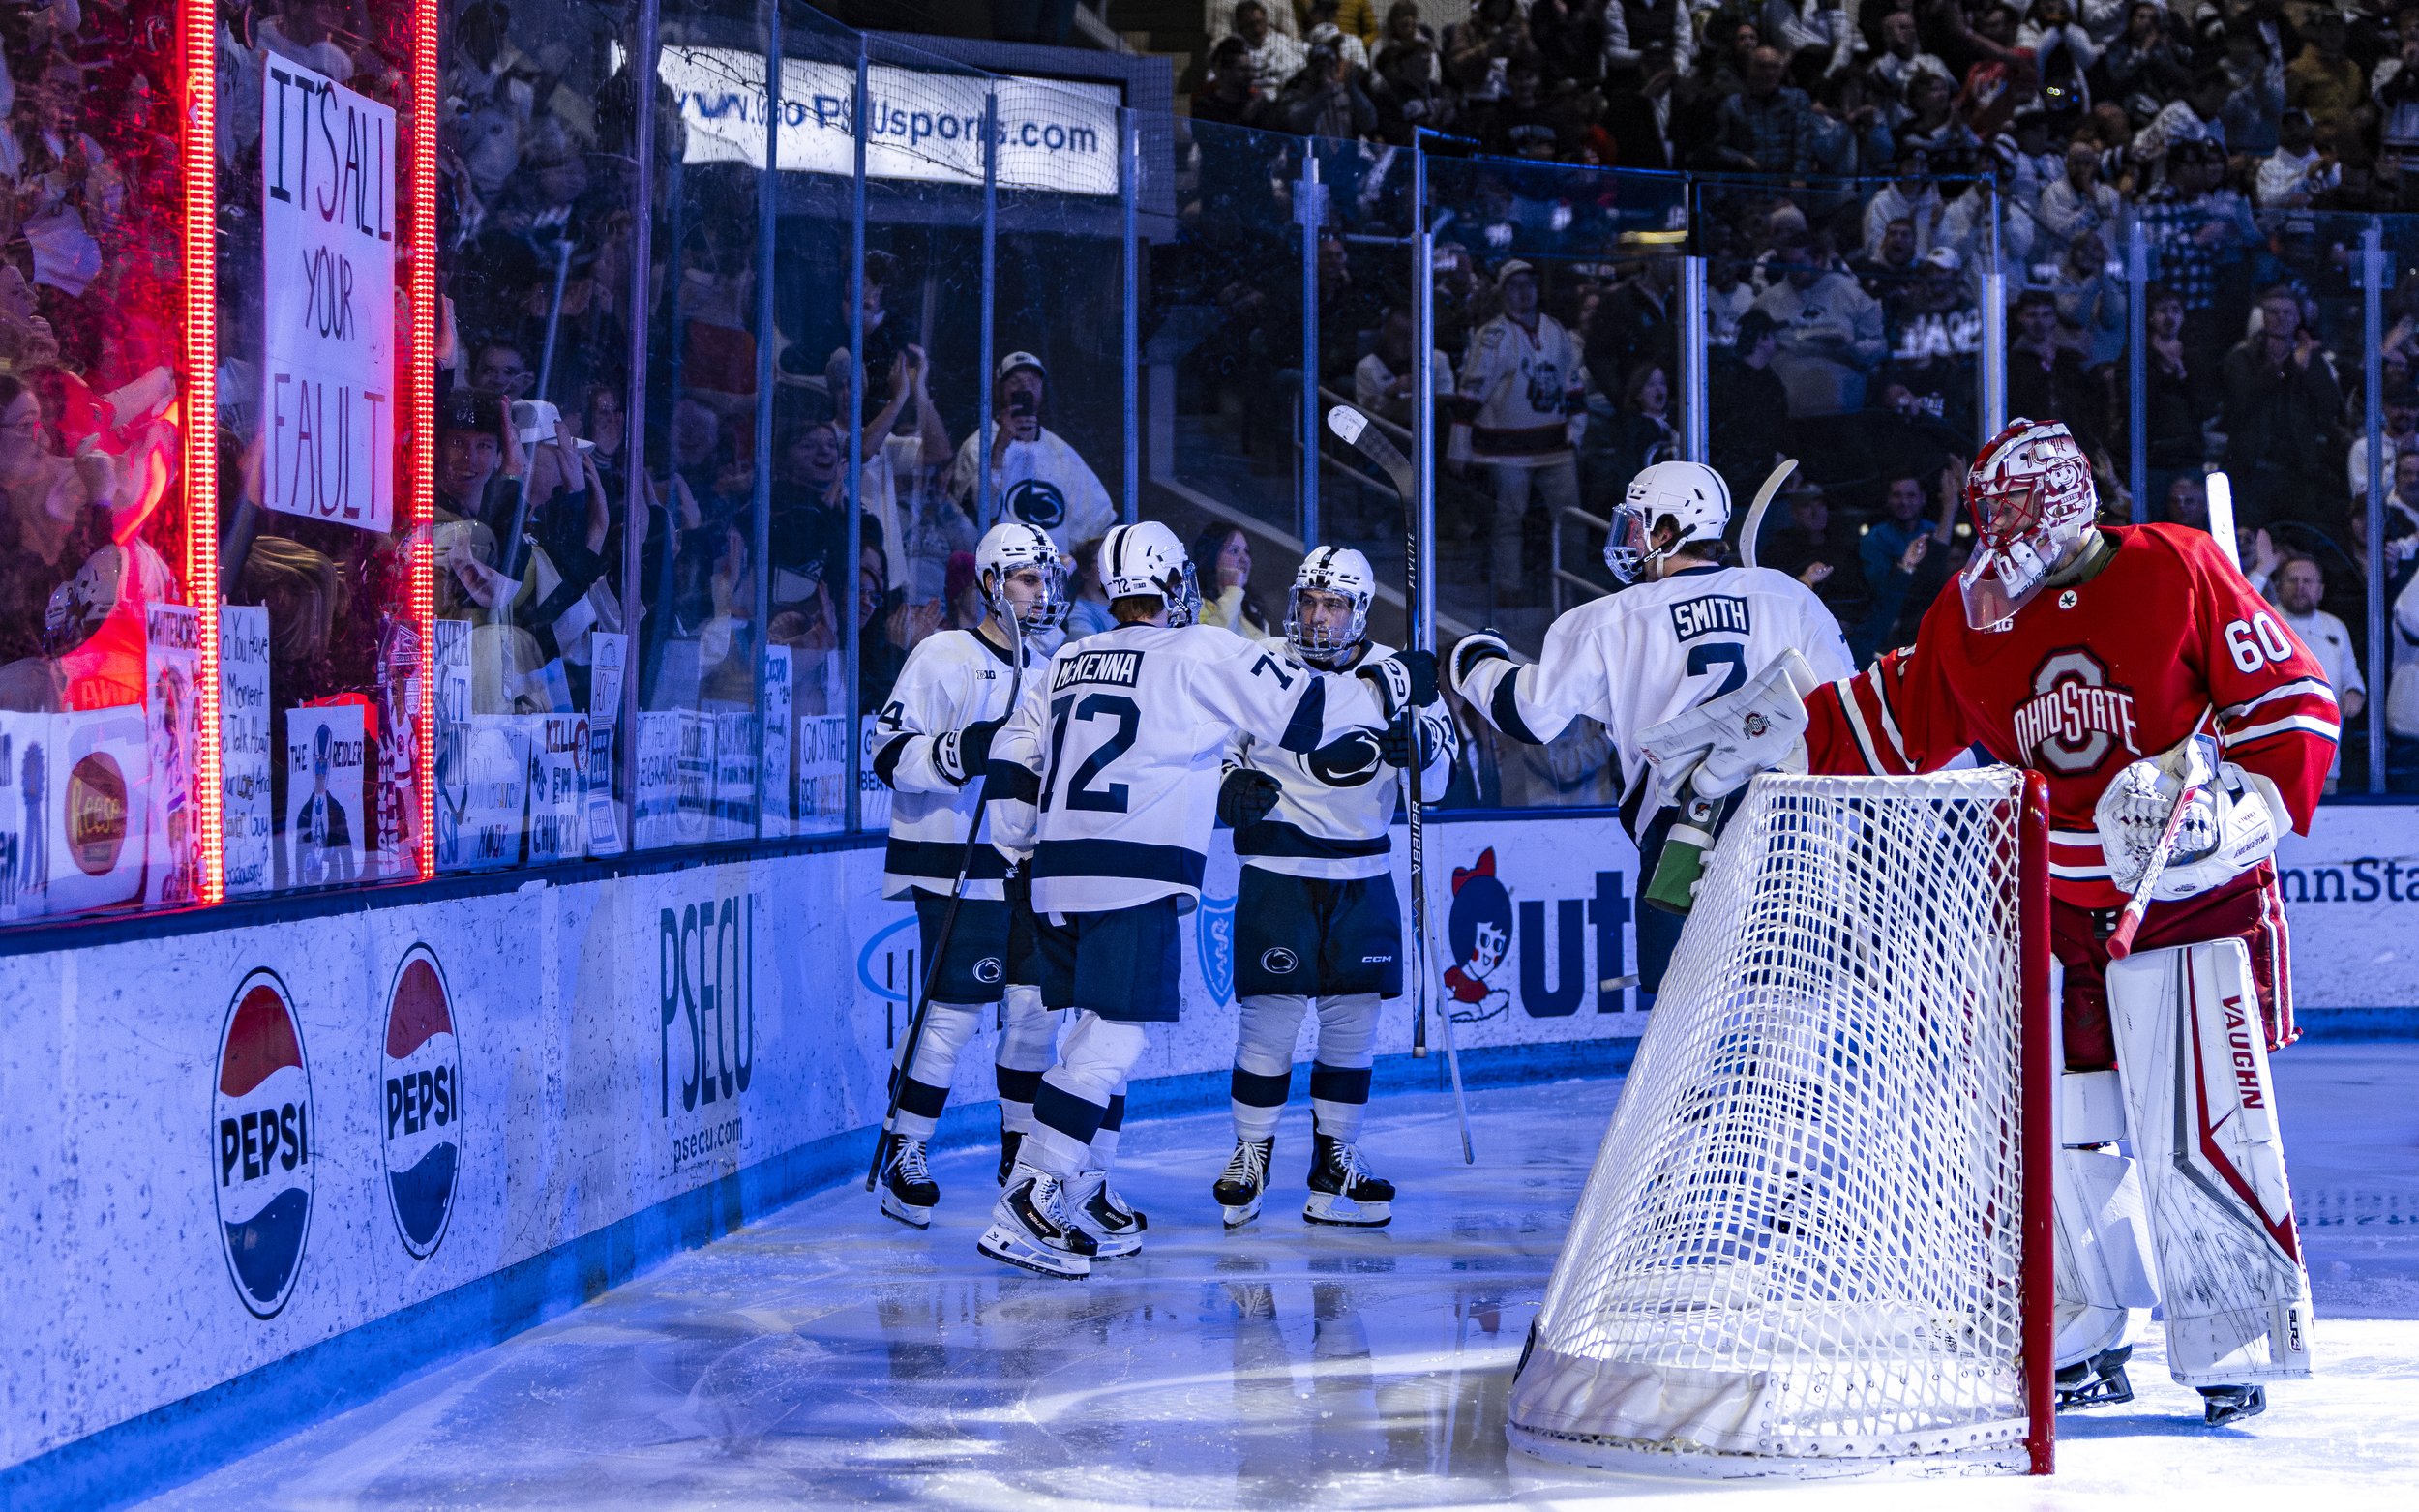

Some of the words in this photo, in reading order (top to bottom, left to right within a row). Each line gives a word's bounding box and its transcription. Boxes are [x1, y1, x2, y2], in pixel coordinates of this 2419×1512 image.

[271, 69, 337, 222] IT'S
[341, 105, 392, 242] ALL
[305, 244, 354, 341] YOUR
[272, 372, 385, 520] FAULT
[1310, 567, 1335, 577] CCM
[1407, 531, 1416, 589] FLYLITE
[1643, 547, 1663, 564] CCM
[1116, 578, 1131, 595] 72
[1174, 596, 1190, 613] CCM
[1674, 597, 1747, 637] SMITH
[433, 620, 470, 667] SHEA
[2224, 610, 2294, 674] 60
[228, 673, 264, 709] Moment
[450, 677, 467, 722] IT
[229, 714, 248, 754] Talk
[546, 718, 576, 755] KILL
[878, 700, 905, 732] 4
[289, 744, 308, 775] THE
[804, 722, 817, 765] GO
[819, 718, 846, 764] STATE
[801, 776, 818, 818] BEAT
[250, 804, 269, 845] Guy
[533, 814, 581, 854] CHUCKY
[1412, 800, 1421, 867] BAUER
[1361, 955, 1393, 964] CCM
[1519, 871, 1653, 1018] ut
[661, 895, 755, 1118] PSECU
[2222, 994, 2265, 1111] VAUGHN
[387, 1064, 459, 1140] PEPSI
[221, 1102, 309, 1189] PEPSI
[672, 1116, 744, 1173] psecu.com
[1027, 1211, 1052, 1235] BAUER
[1105, 1211, 1126, 1226] BAUER
